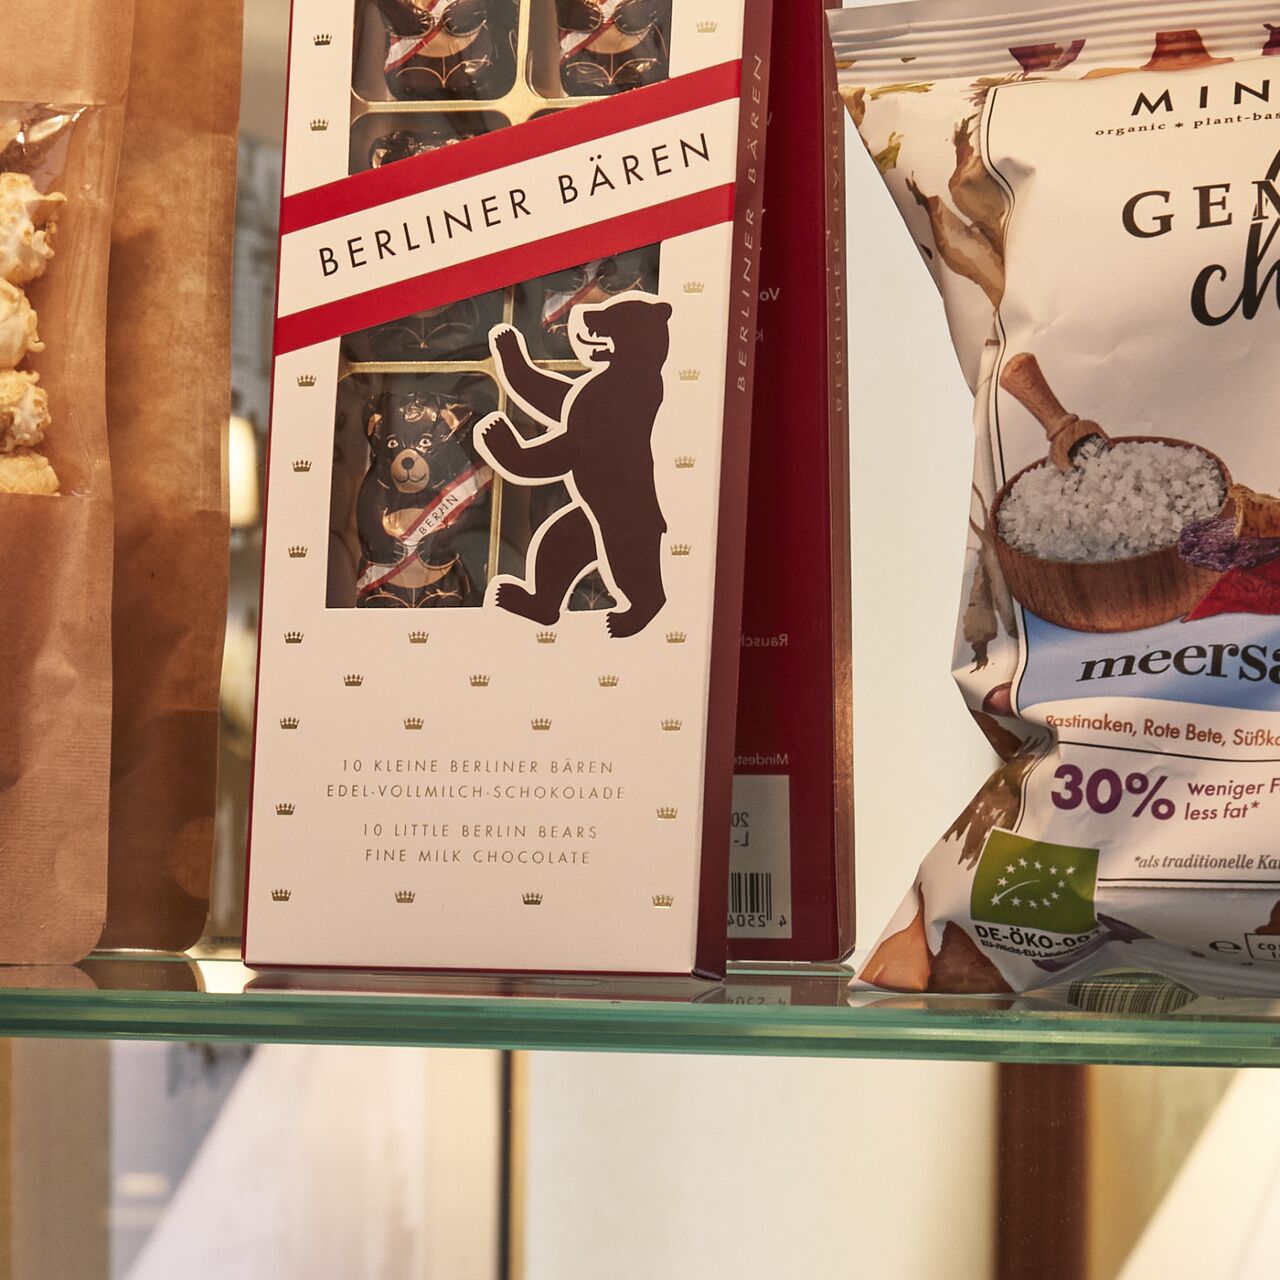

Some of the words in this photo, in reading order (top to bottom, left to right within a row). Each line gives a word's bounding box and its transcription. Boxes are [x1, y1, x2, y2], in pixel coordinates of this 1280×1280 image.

[1095, 122, 1166, 136] organic
[319, 188, 533, 278] BERLINER
[558, 132, 712, 206] BÄREN
[737, 208, 756, 393] BERLINER
[747, 54, 763, 184] BÄREN
[1143, 718, 1181, 740] Rote
[1185, 723, 1227, 747] Bete,
[342, 759, 363, 773] 10
[374, 759, 440, 773] KLEINE
[450, 760, 539, 774] BERLINER
[550, 757, 614, 774] BÄREN
[326, 784, 625, 801] EDEL-VOLLMILCH-SCHOKOLADE
[1051, 763, 1176, 821] 30%
[1187, 778, 1265, 801] weniger
[1184, 802, 1218, 821] less
[362, 823, 383, 837] 10
[394, 824, 450, 838] LITTLE
[462, 825, 528, 839] BERLIN
[538, 825, 599, 840] BEARS
[365, 848, 408, 863] FINE
[418, 849, 463, 864] MILK
[472, 850, 590, 865] CHOCOLATE
[1162, 854, 1254, 870] traditionelle
[974, 924, 1101, 949] DE-ÖKO-00
